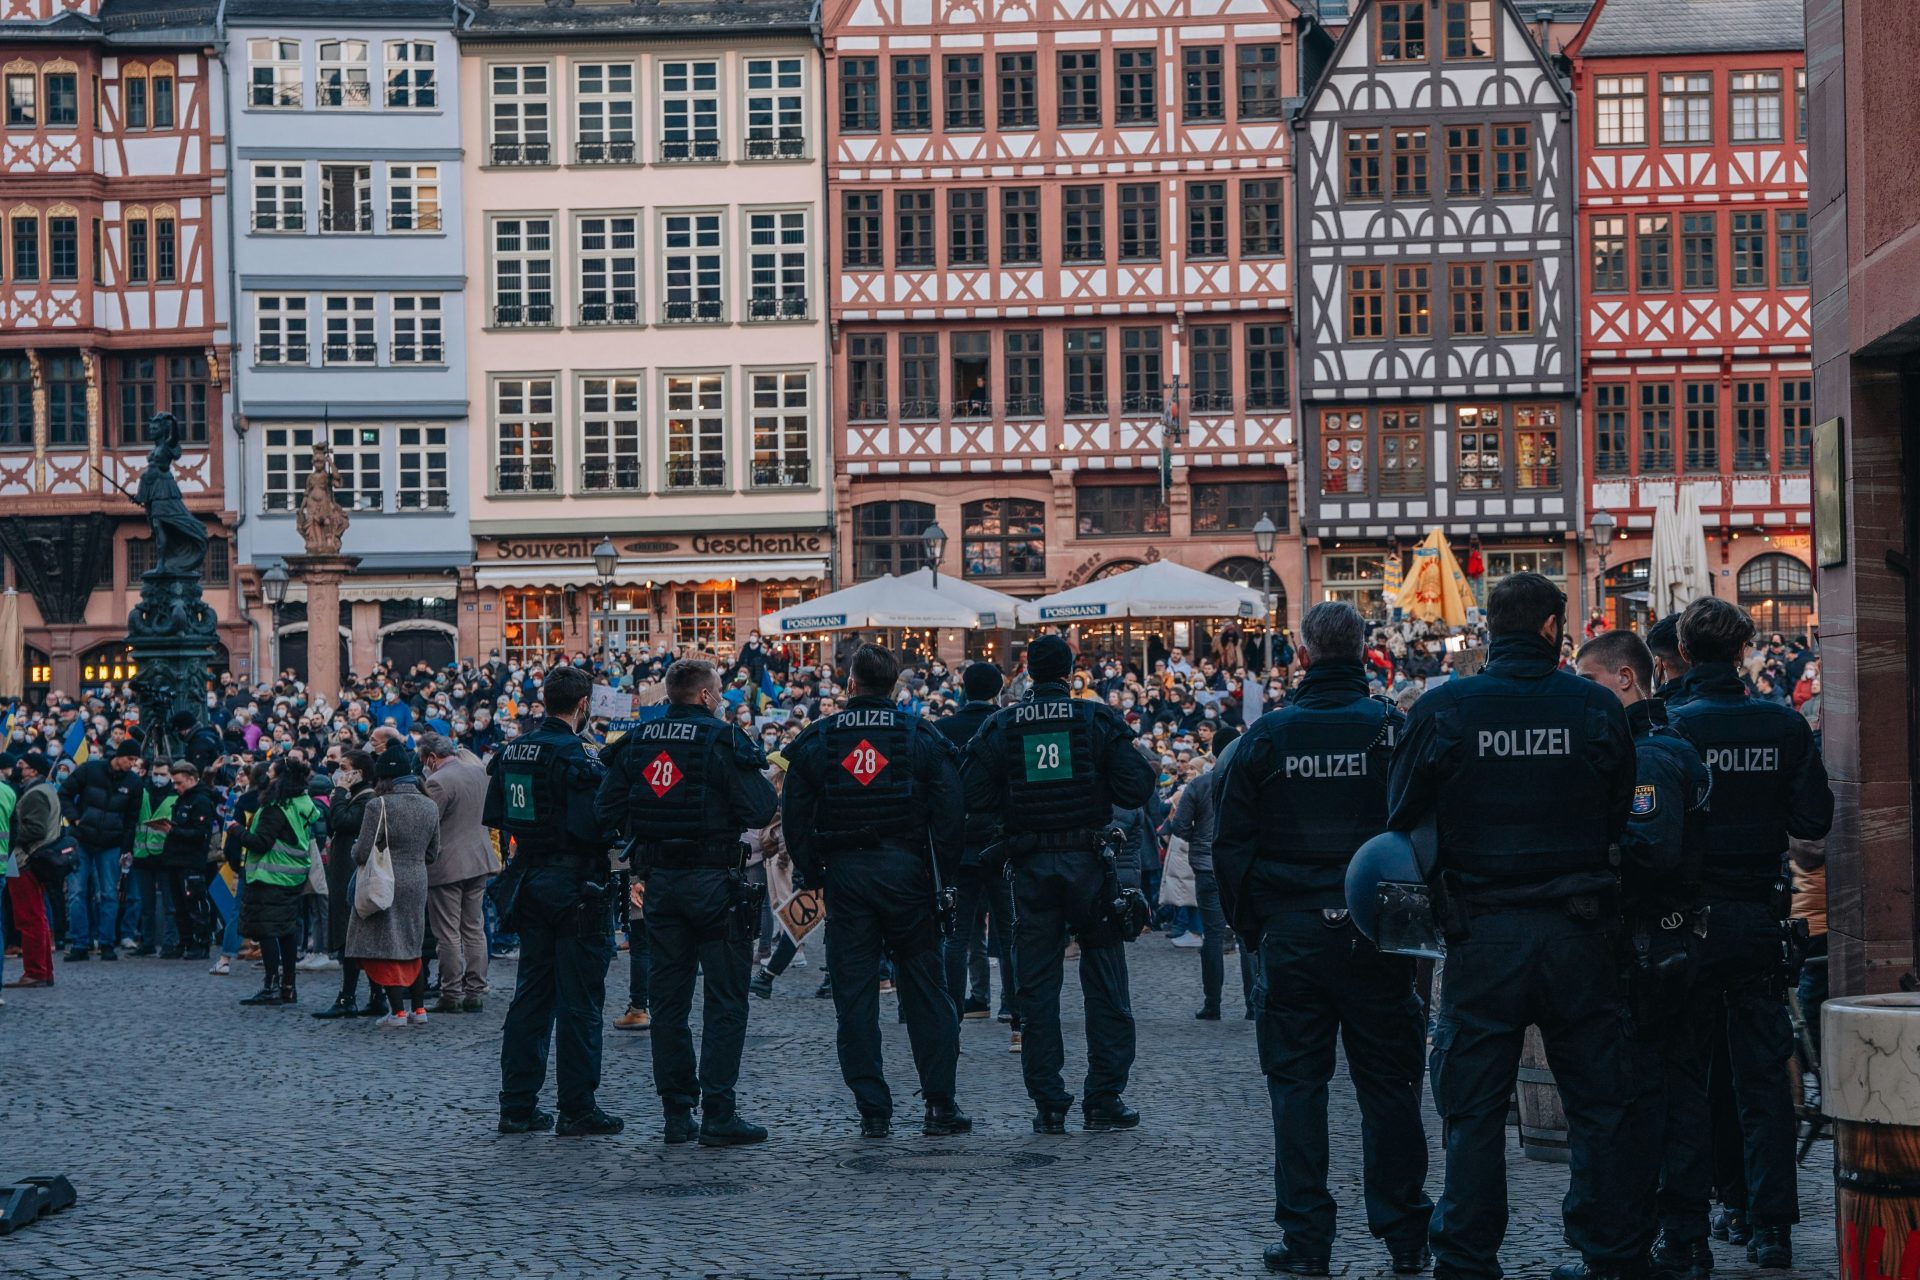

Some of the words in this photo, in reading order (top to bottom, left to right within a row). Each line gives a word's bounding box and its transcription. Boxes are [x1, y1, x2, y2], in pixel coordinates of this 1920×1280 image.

[692, 533, 820, 554] Geschenke
[786, 616, 841, 628] POSSMANN
[1045, 605, 1101, 617] POSSMANN
[836, 710, 894, 728] POLIZEI
[1016, 702, 1073, 723] POLIZEI
[642, 723, 697, 740] POLIZEI
[1478, 728, 1571, 757] POLIZEI
[503, 744, 541, 761] POLIZEI
[853, 748, 876, 774] 28
[1036, 743, 1060, 769] 28
[1706, 747, 1779, 772] POLIZEI
[652, 760, 673, 787] 28
[1286, 752, 1367, 778] POLIZEI
[510, 783, 526, 808] 28
